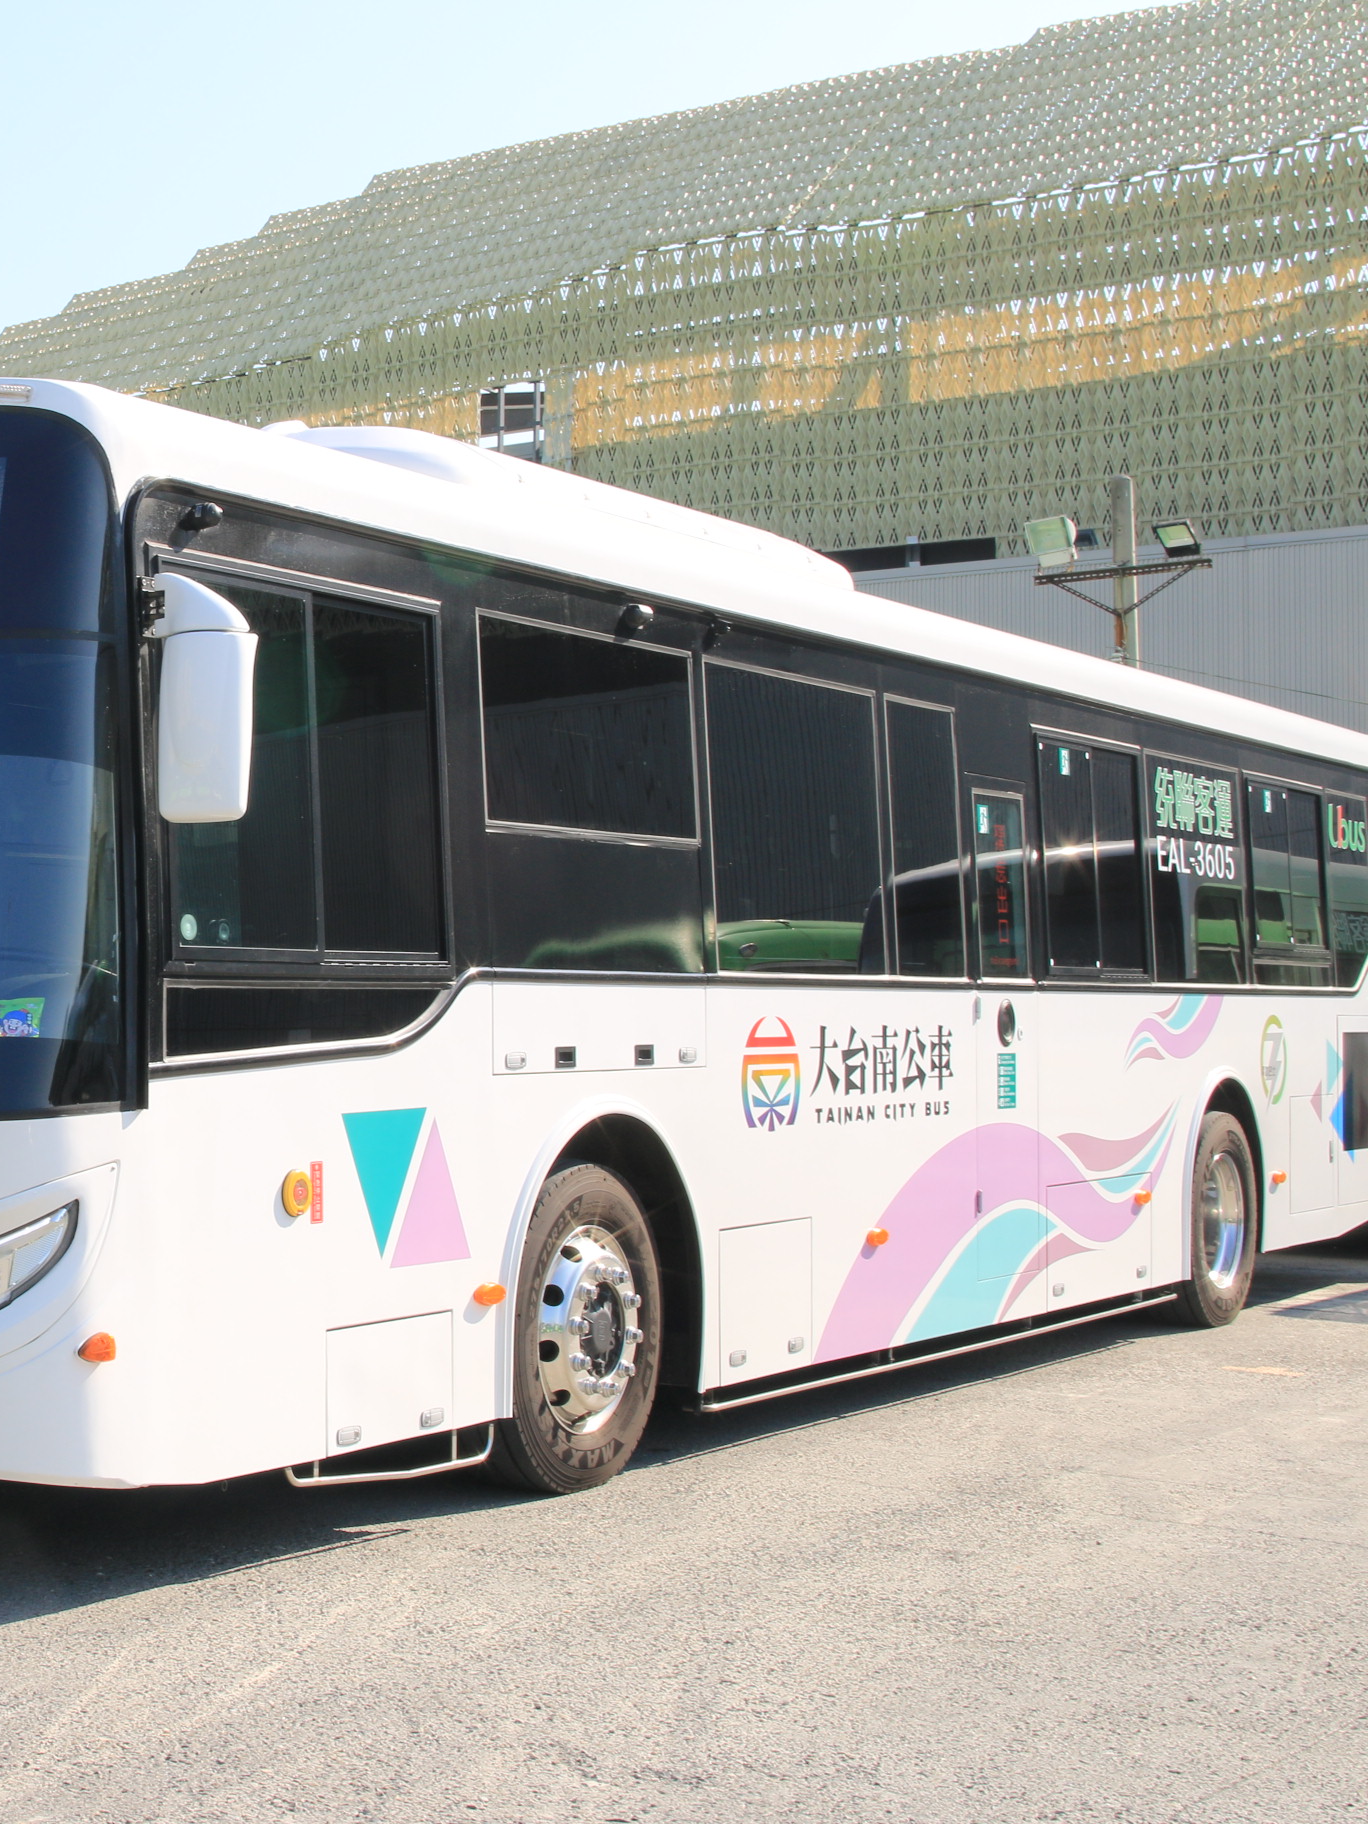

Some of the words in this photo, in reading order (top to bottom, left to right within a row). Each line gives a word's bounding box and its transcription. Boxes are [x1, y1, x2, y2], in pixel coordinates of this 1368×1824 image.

[1156, 835, 1235, 880] EAL-3605
[809, 1024, 954, 1098] 大台南公車
[815, 1105, 876, 1126] TAINAN
[884, 1103, 917, 1121] CITY
[926, 1100, 950, 1116] BUS
